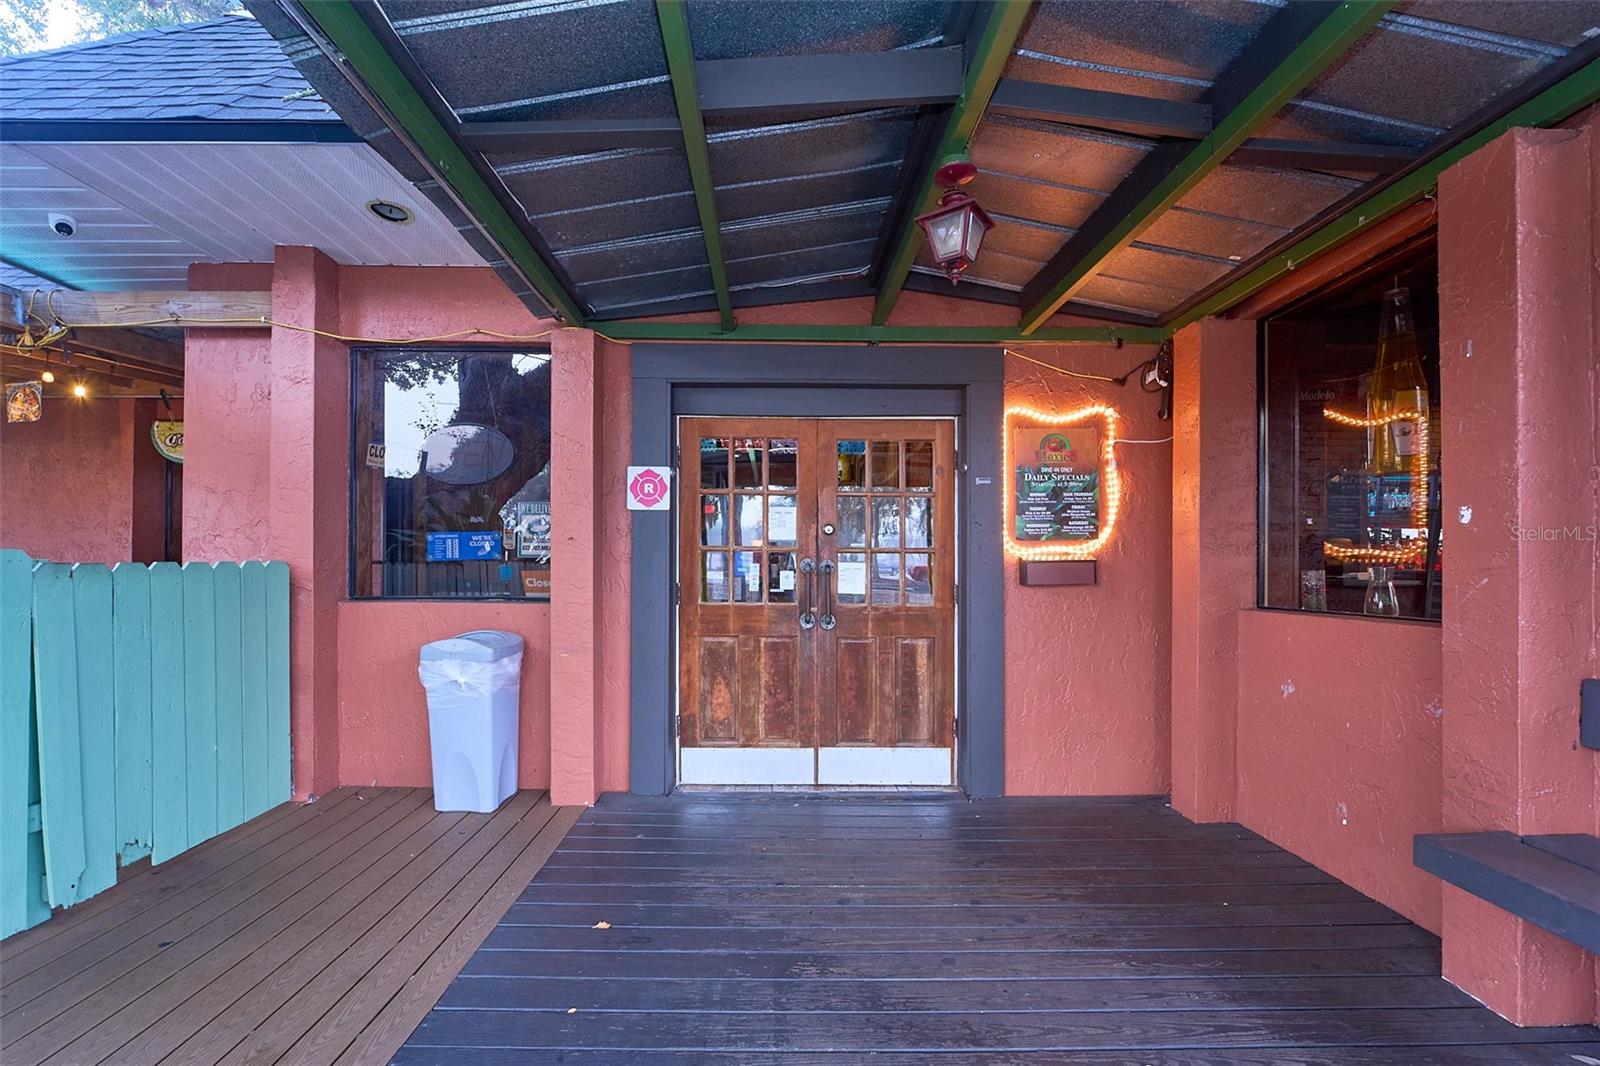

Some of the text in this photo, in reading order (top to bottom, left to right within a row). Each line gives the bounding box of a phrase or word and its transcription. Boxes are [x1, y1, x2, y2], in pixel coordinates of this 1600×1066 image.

[1024, 472, 1090, 481] DAILY SPECIALS
[644, 483, 655, 494] R
